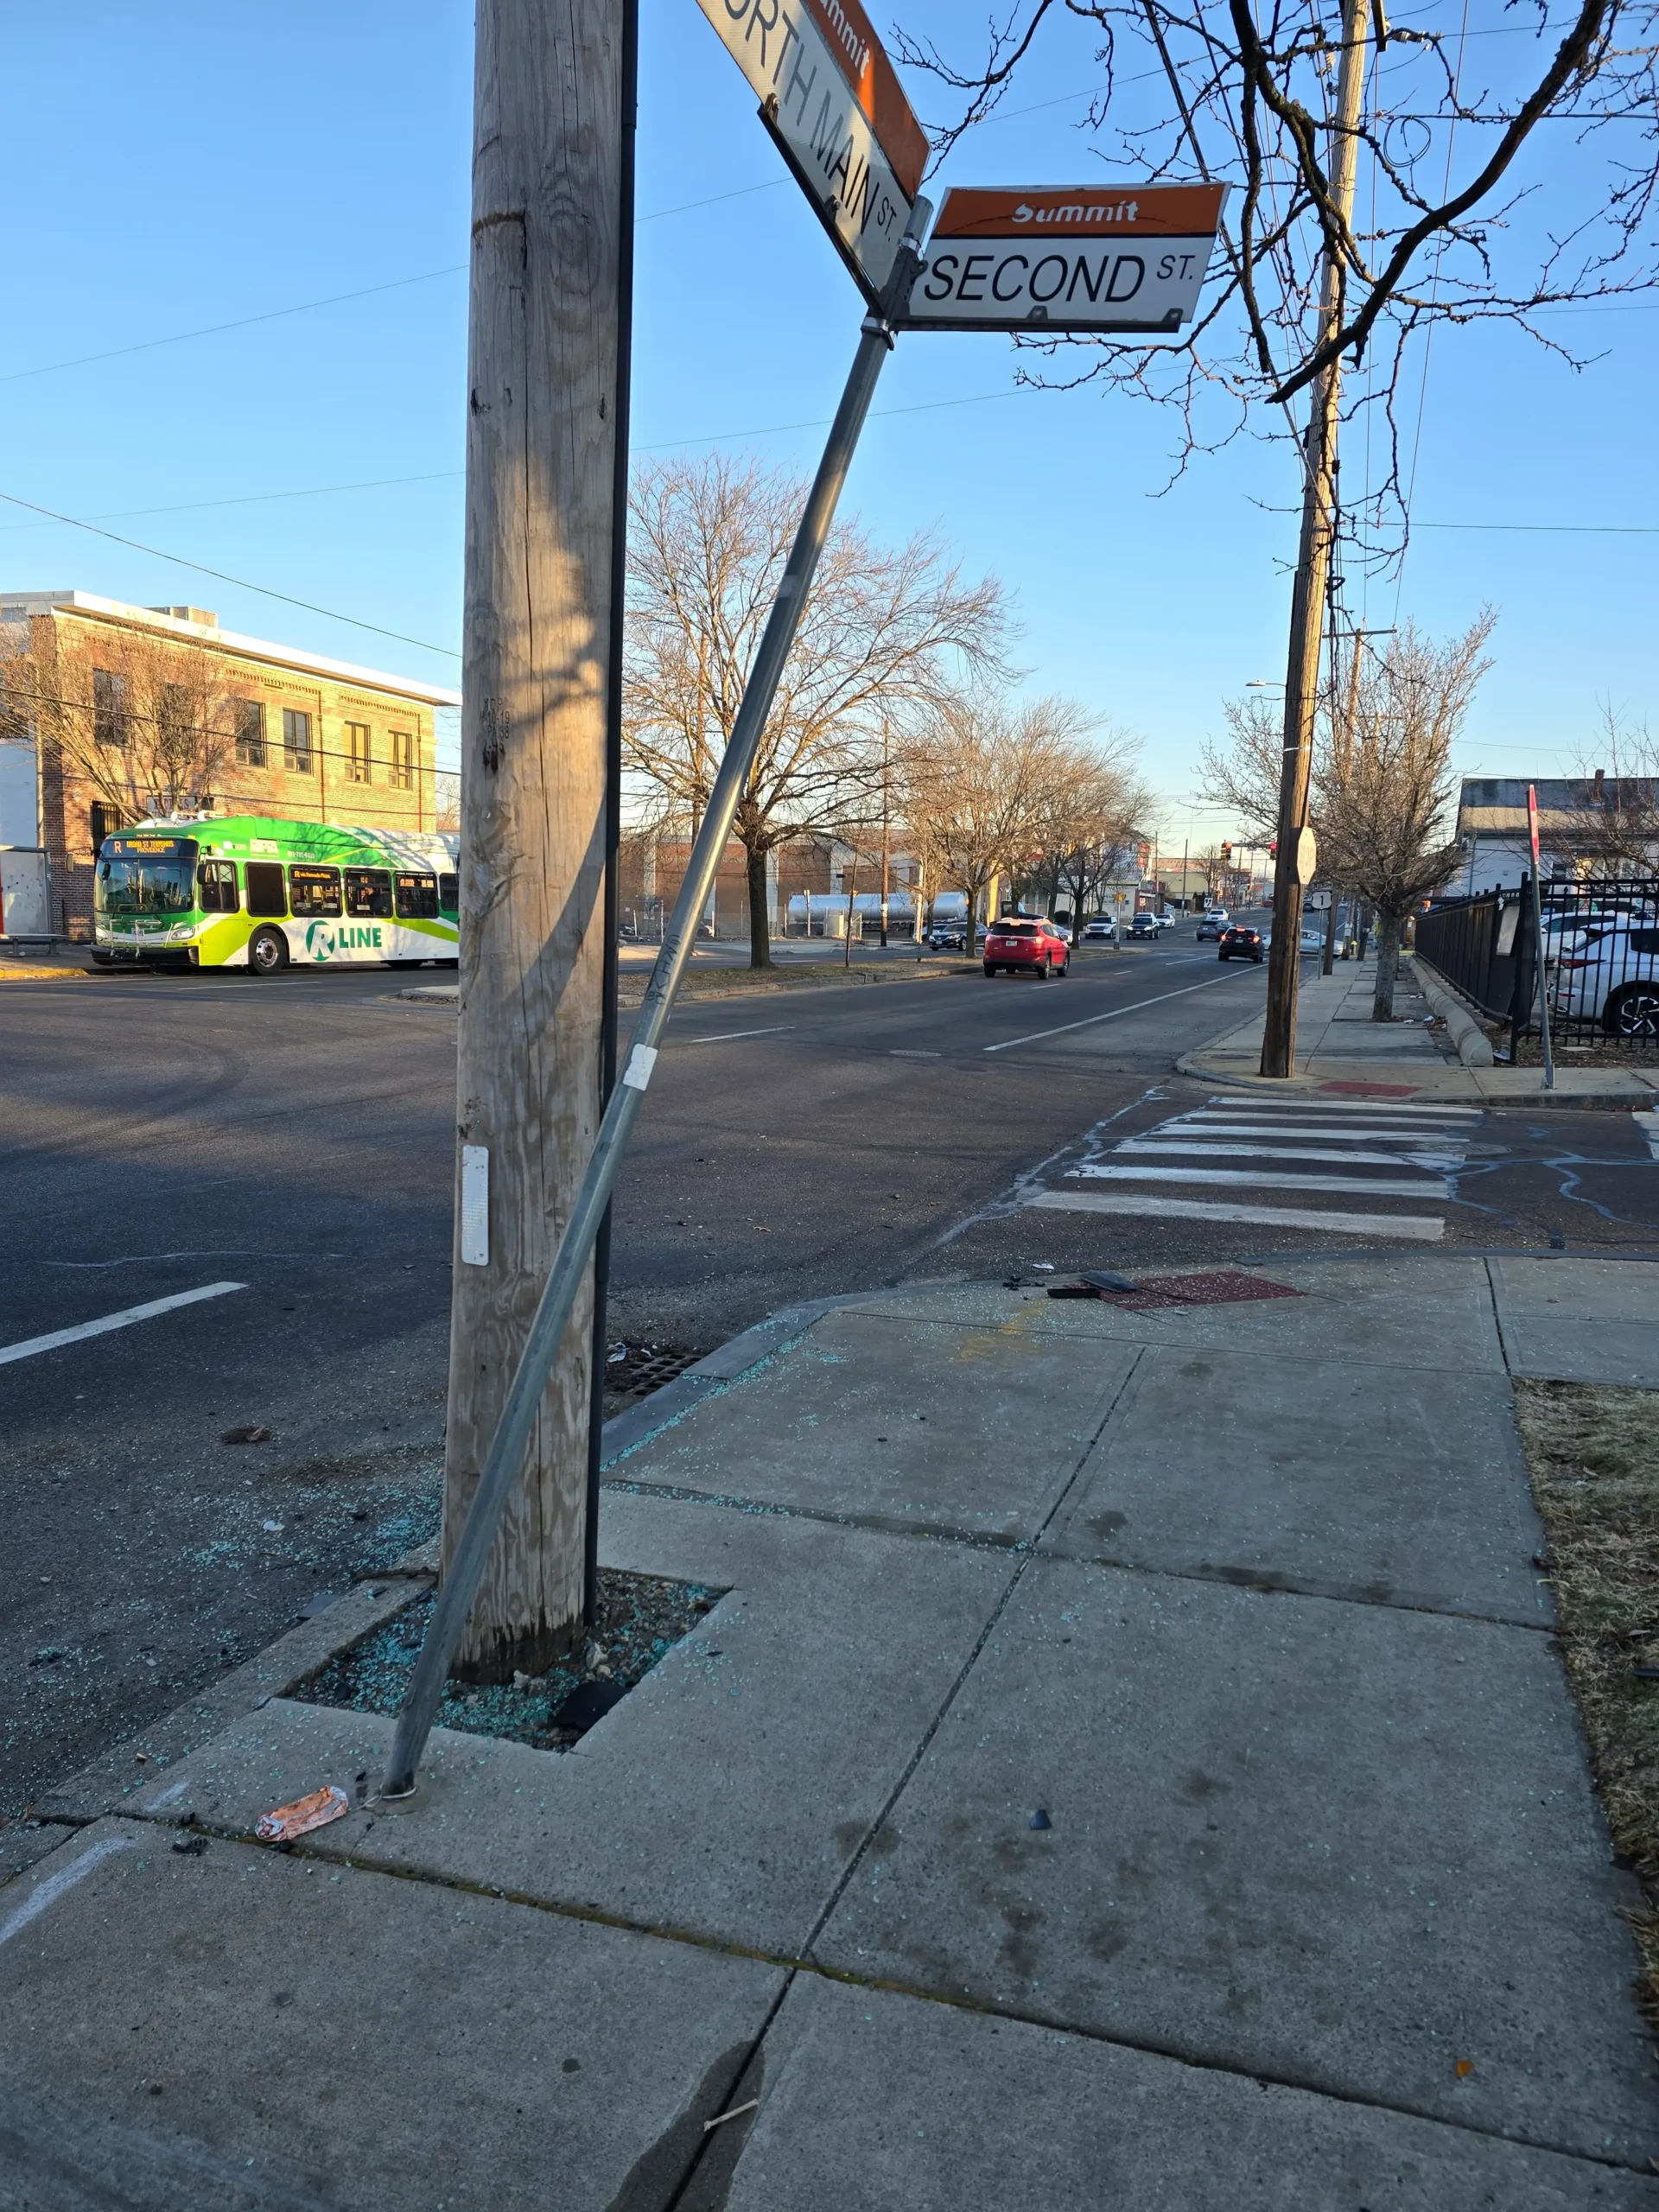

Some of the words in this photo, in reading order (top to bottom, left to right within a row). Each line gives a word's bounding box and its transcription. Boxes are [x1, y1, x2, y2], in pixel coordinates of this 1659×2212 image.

[810, 89, 880, 237] MAIN
[877, 196, 897, 242] ST.
[1011, 200, 1139, 223] Summit
[924, 254, 1146, 302] SECOND
[1156, 254, 1196, 280] ST.
[114, 842, 122, 854] R
[308, 924, 334, 957] R
[339, 927, 382, 949] LINE
